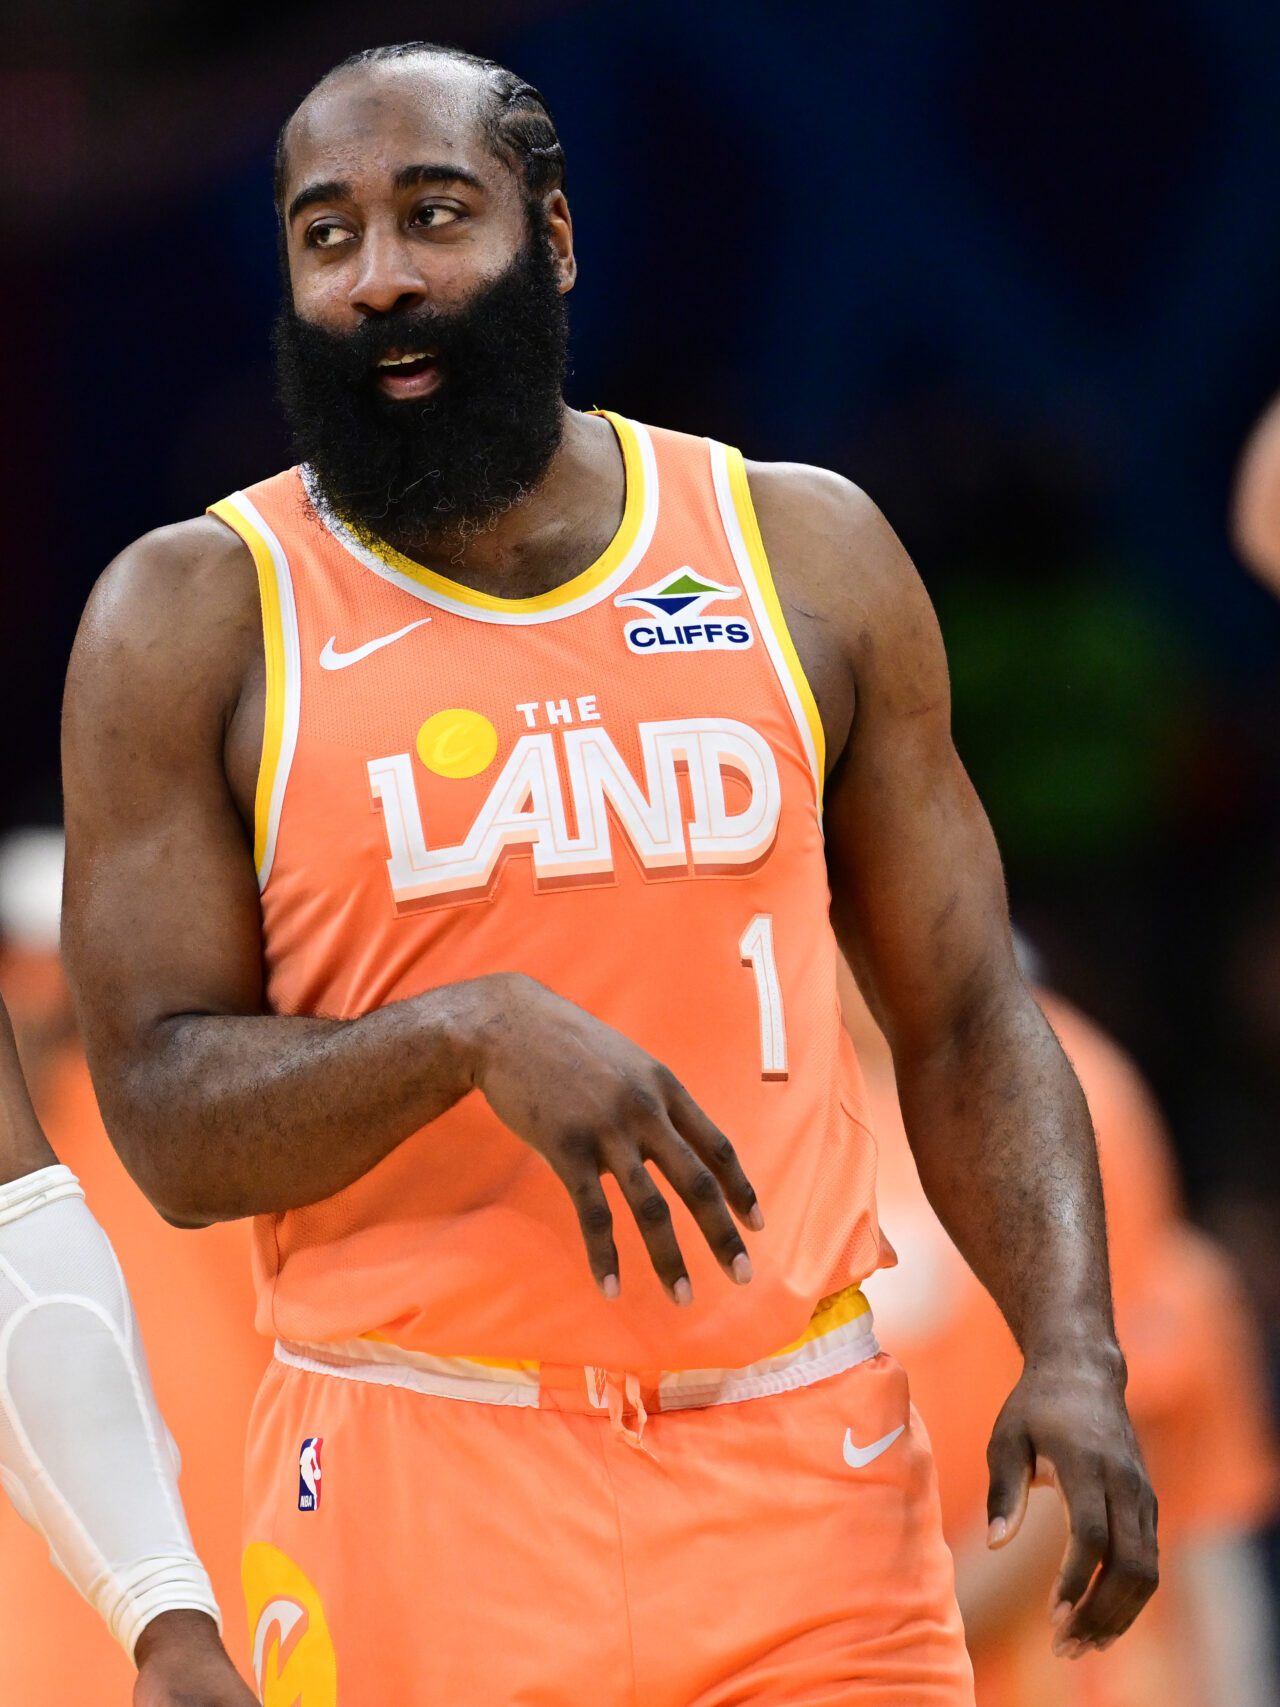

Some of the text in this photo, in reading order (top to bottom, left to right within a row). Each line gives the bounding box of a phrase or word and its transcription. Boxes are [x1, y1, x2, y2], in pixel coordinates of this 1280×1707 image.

[630, 624, 750, 647] CLIFFS
[515, 695, 601, 728] THE
[367, 718, 782, 917] LAND
[740, 914, 789, 1081] 1
[300, 1495, 312, 1507] NBA
